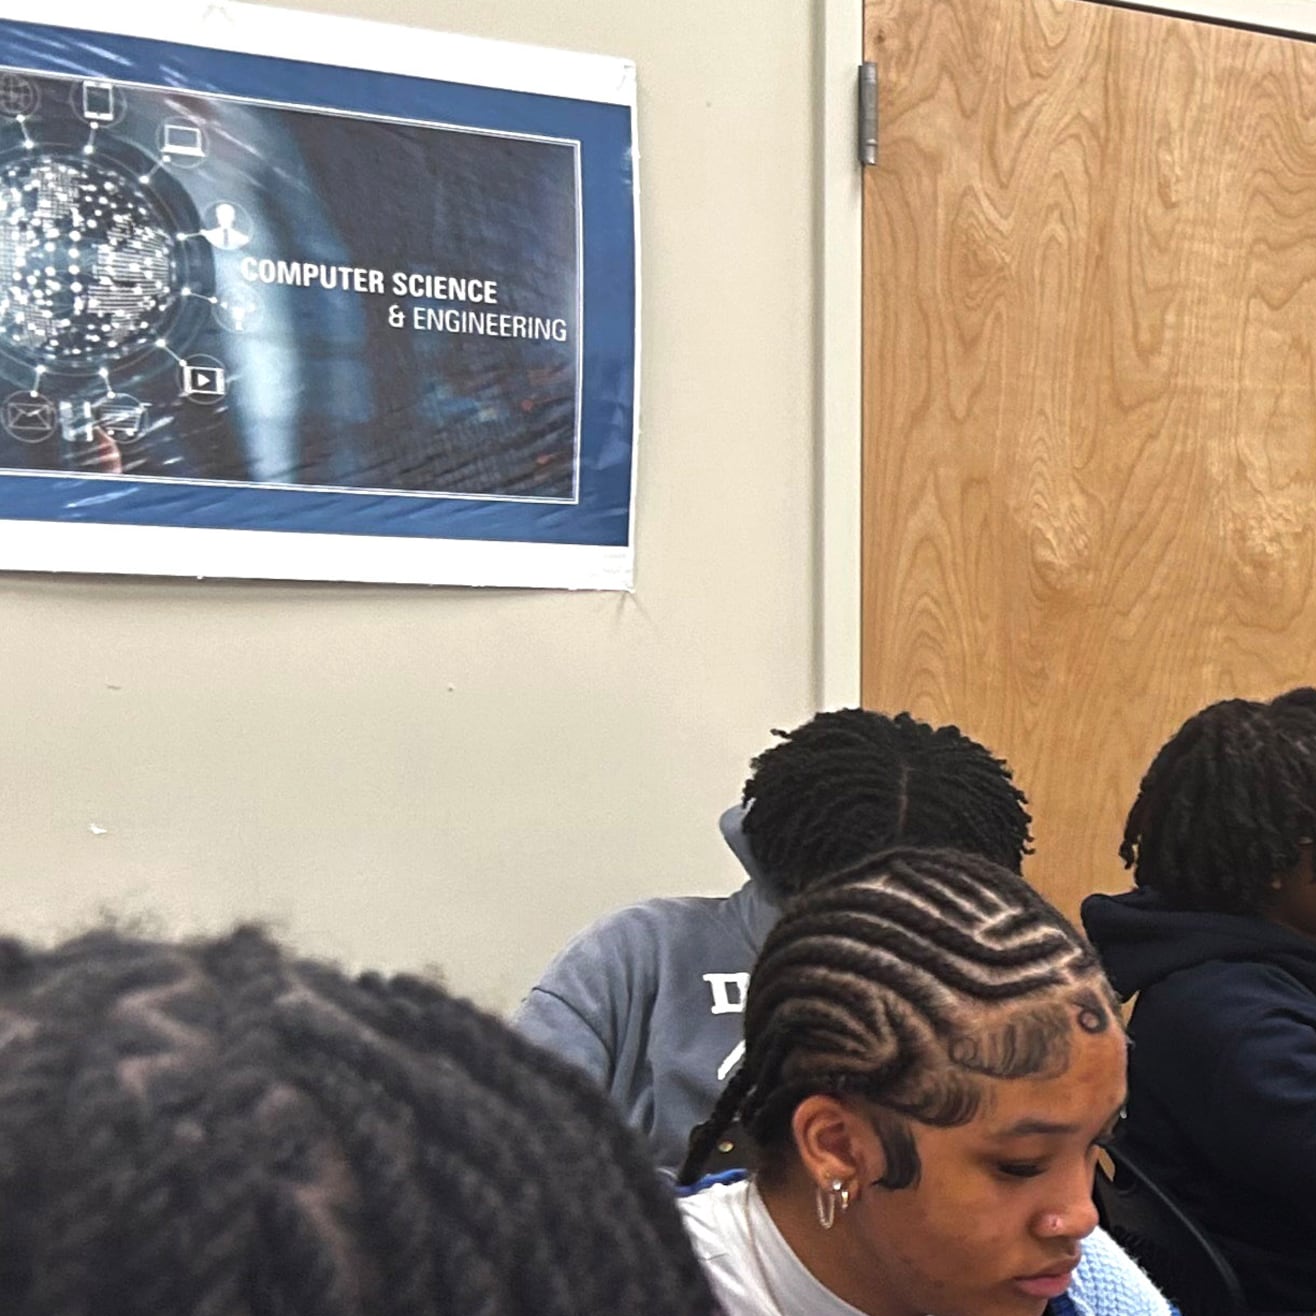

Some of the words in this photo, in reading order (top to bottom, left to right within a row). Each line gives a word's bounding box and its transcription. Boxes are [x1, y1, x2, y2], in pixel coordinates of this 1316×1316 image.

[241, 257, 384, 293] COMPUTER
[392, 272, 498, 304] SCIENCE
[388, 304, 405, 327] &
[413, 307, 567, 342] ENGINEERING
